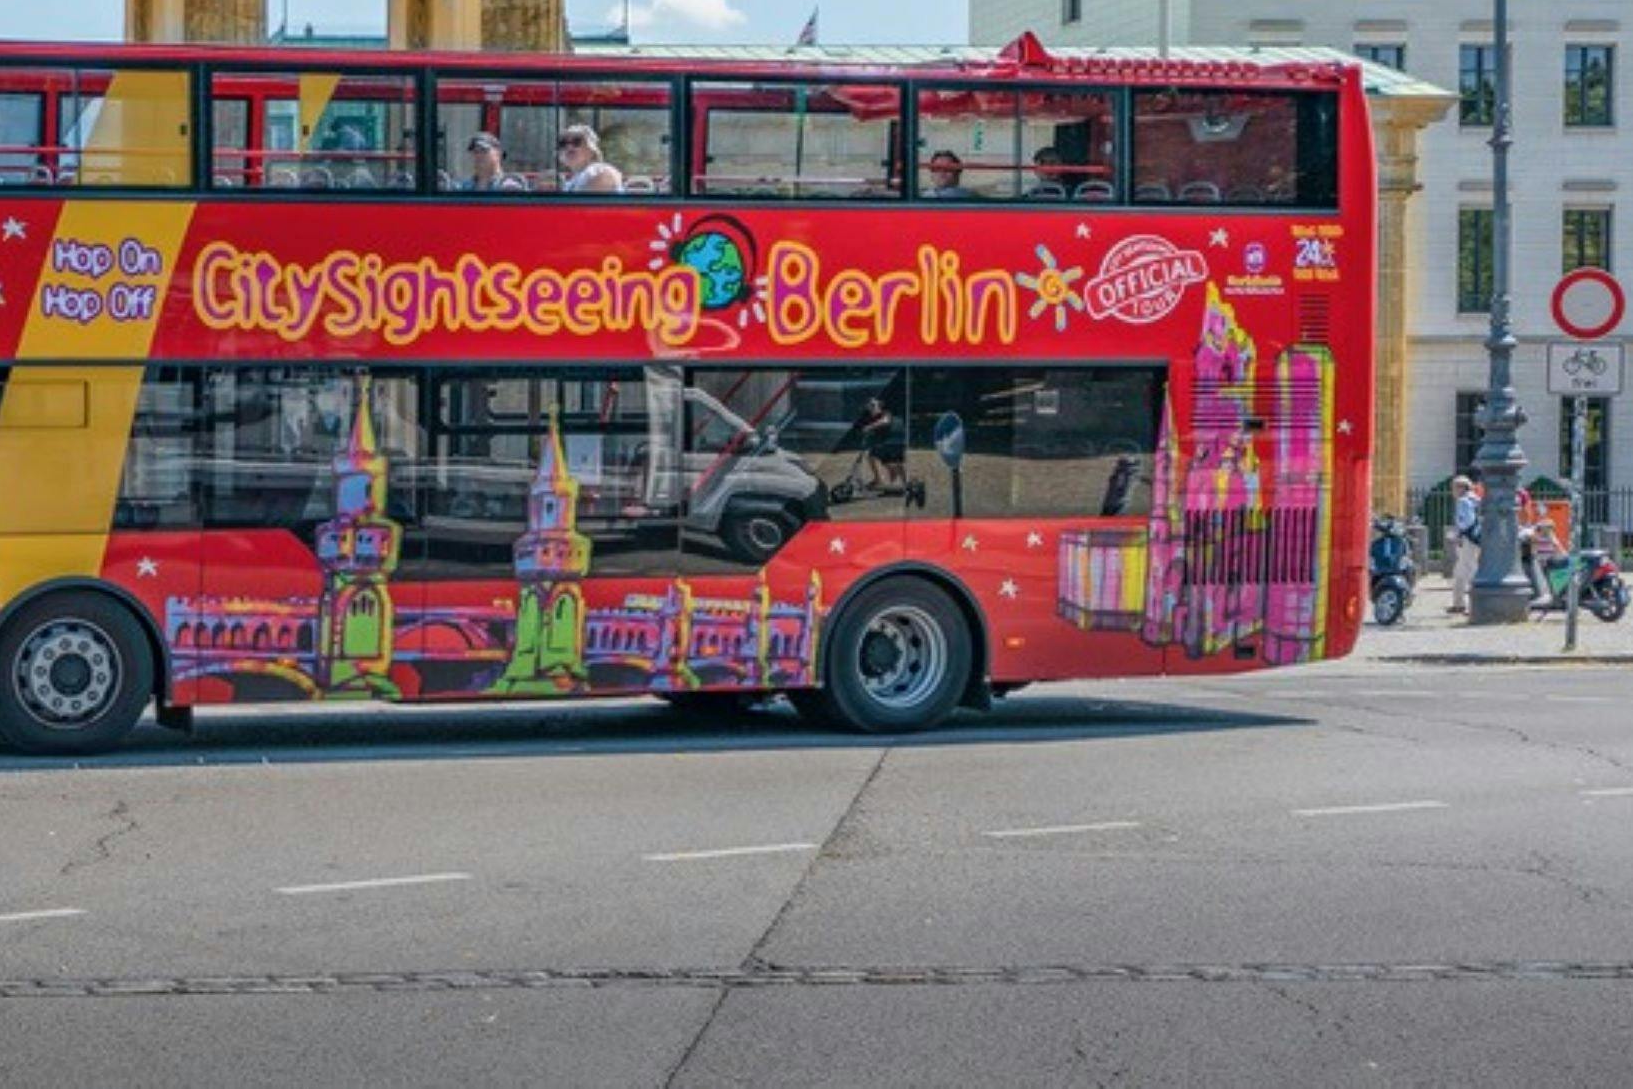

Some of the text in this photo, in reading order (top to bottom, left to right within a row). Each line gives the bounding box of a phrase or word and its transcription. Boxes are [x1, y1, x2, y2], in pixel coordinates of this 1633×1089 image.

[53, 236, 162, 279] Hop On
[1098, 255, 1199, 308] OFFICIAL
[41, 281, 156, 326] Hop Off
[767, 241, 1017, 348] Berlin
